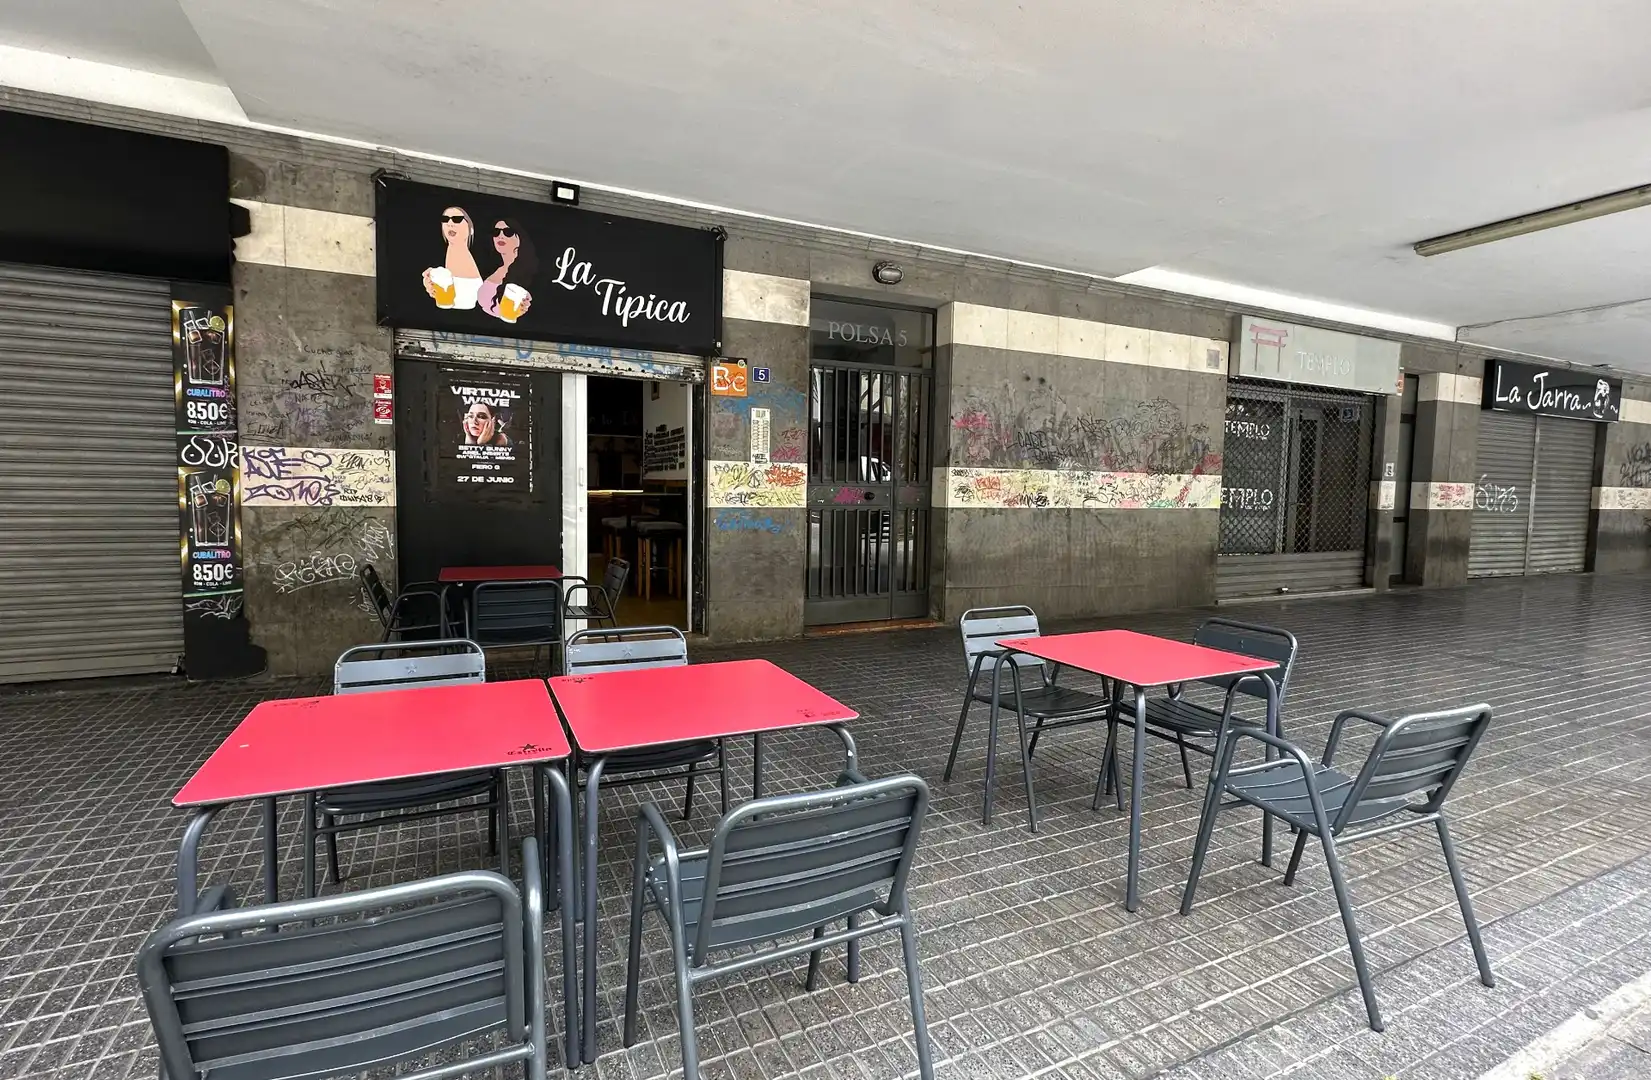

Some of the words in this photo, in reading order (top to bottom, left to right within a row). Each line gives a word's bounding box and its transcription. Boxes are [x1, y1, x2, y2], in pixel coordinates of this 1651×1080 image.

[551, 247, 597, 290] La
[828, 321, 893, 346] POLSA
[898, 329, 908, 347] 5
[1297, 350, 1351, 376] TEMPLO
[758, 370, 766, 380] 5
[186, 388, 226, 398] CUBALITRO
[450, 386, 520, 399] VIRTUAL
[1496, 365, 1521, 403] La
[1527, 371, 1581, 411] Jarra
[462, 396, 510, 407] WAVE
[1224, 420, 1270, 437] TEMPLO
[486, 476, 515, 484] JUNIO
[1220, 487, 1274, 509] EMPLO
[193, 551, 232, 559] CUBALITRO
